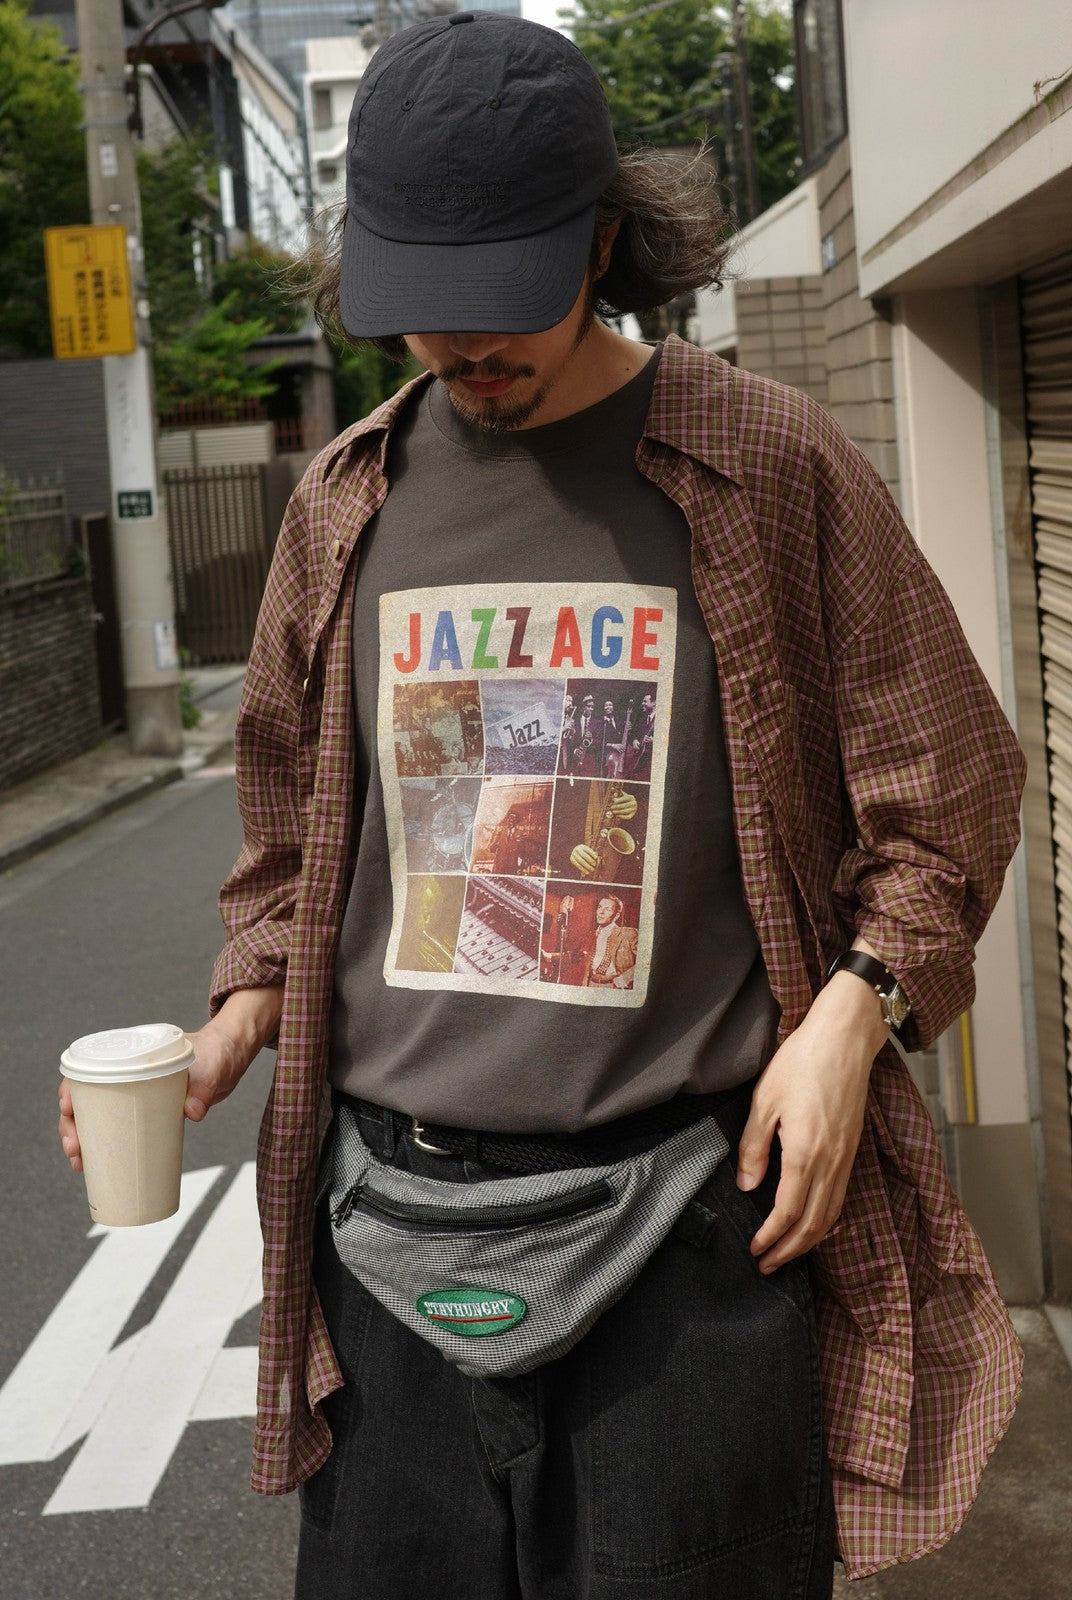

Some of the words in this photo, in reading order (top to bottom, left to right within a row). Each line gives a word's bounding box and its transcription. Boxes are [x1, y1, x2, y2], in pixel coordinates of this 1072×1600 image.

[393, 607, 533, 674] JAZZ
[549, 605, 664, 671] AGE
[503, 719, 545, 749] Jazz
